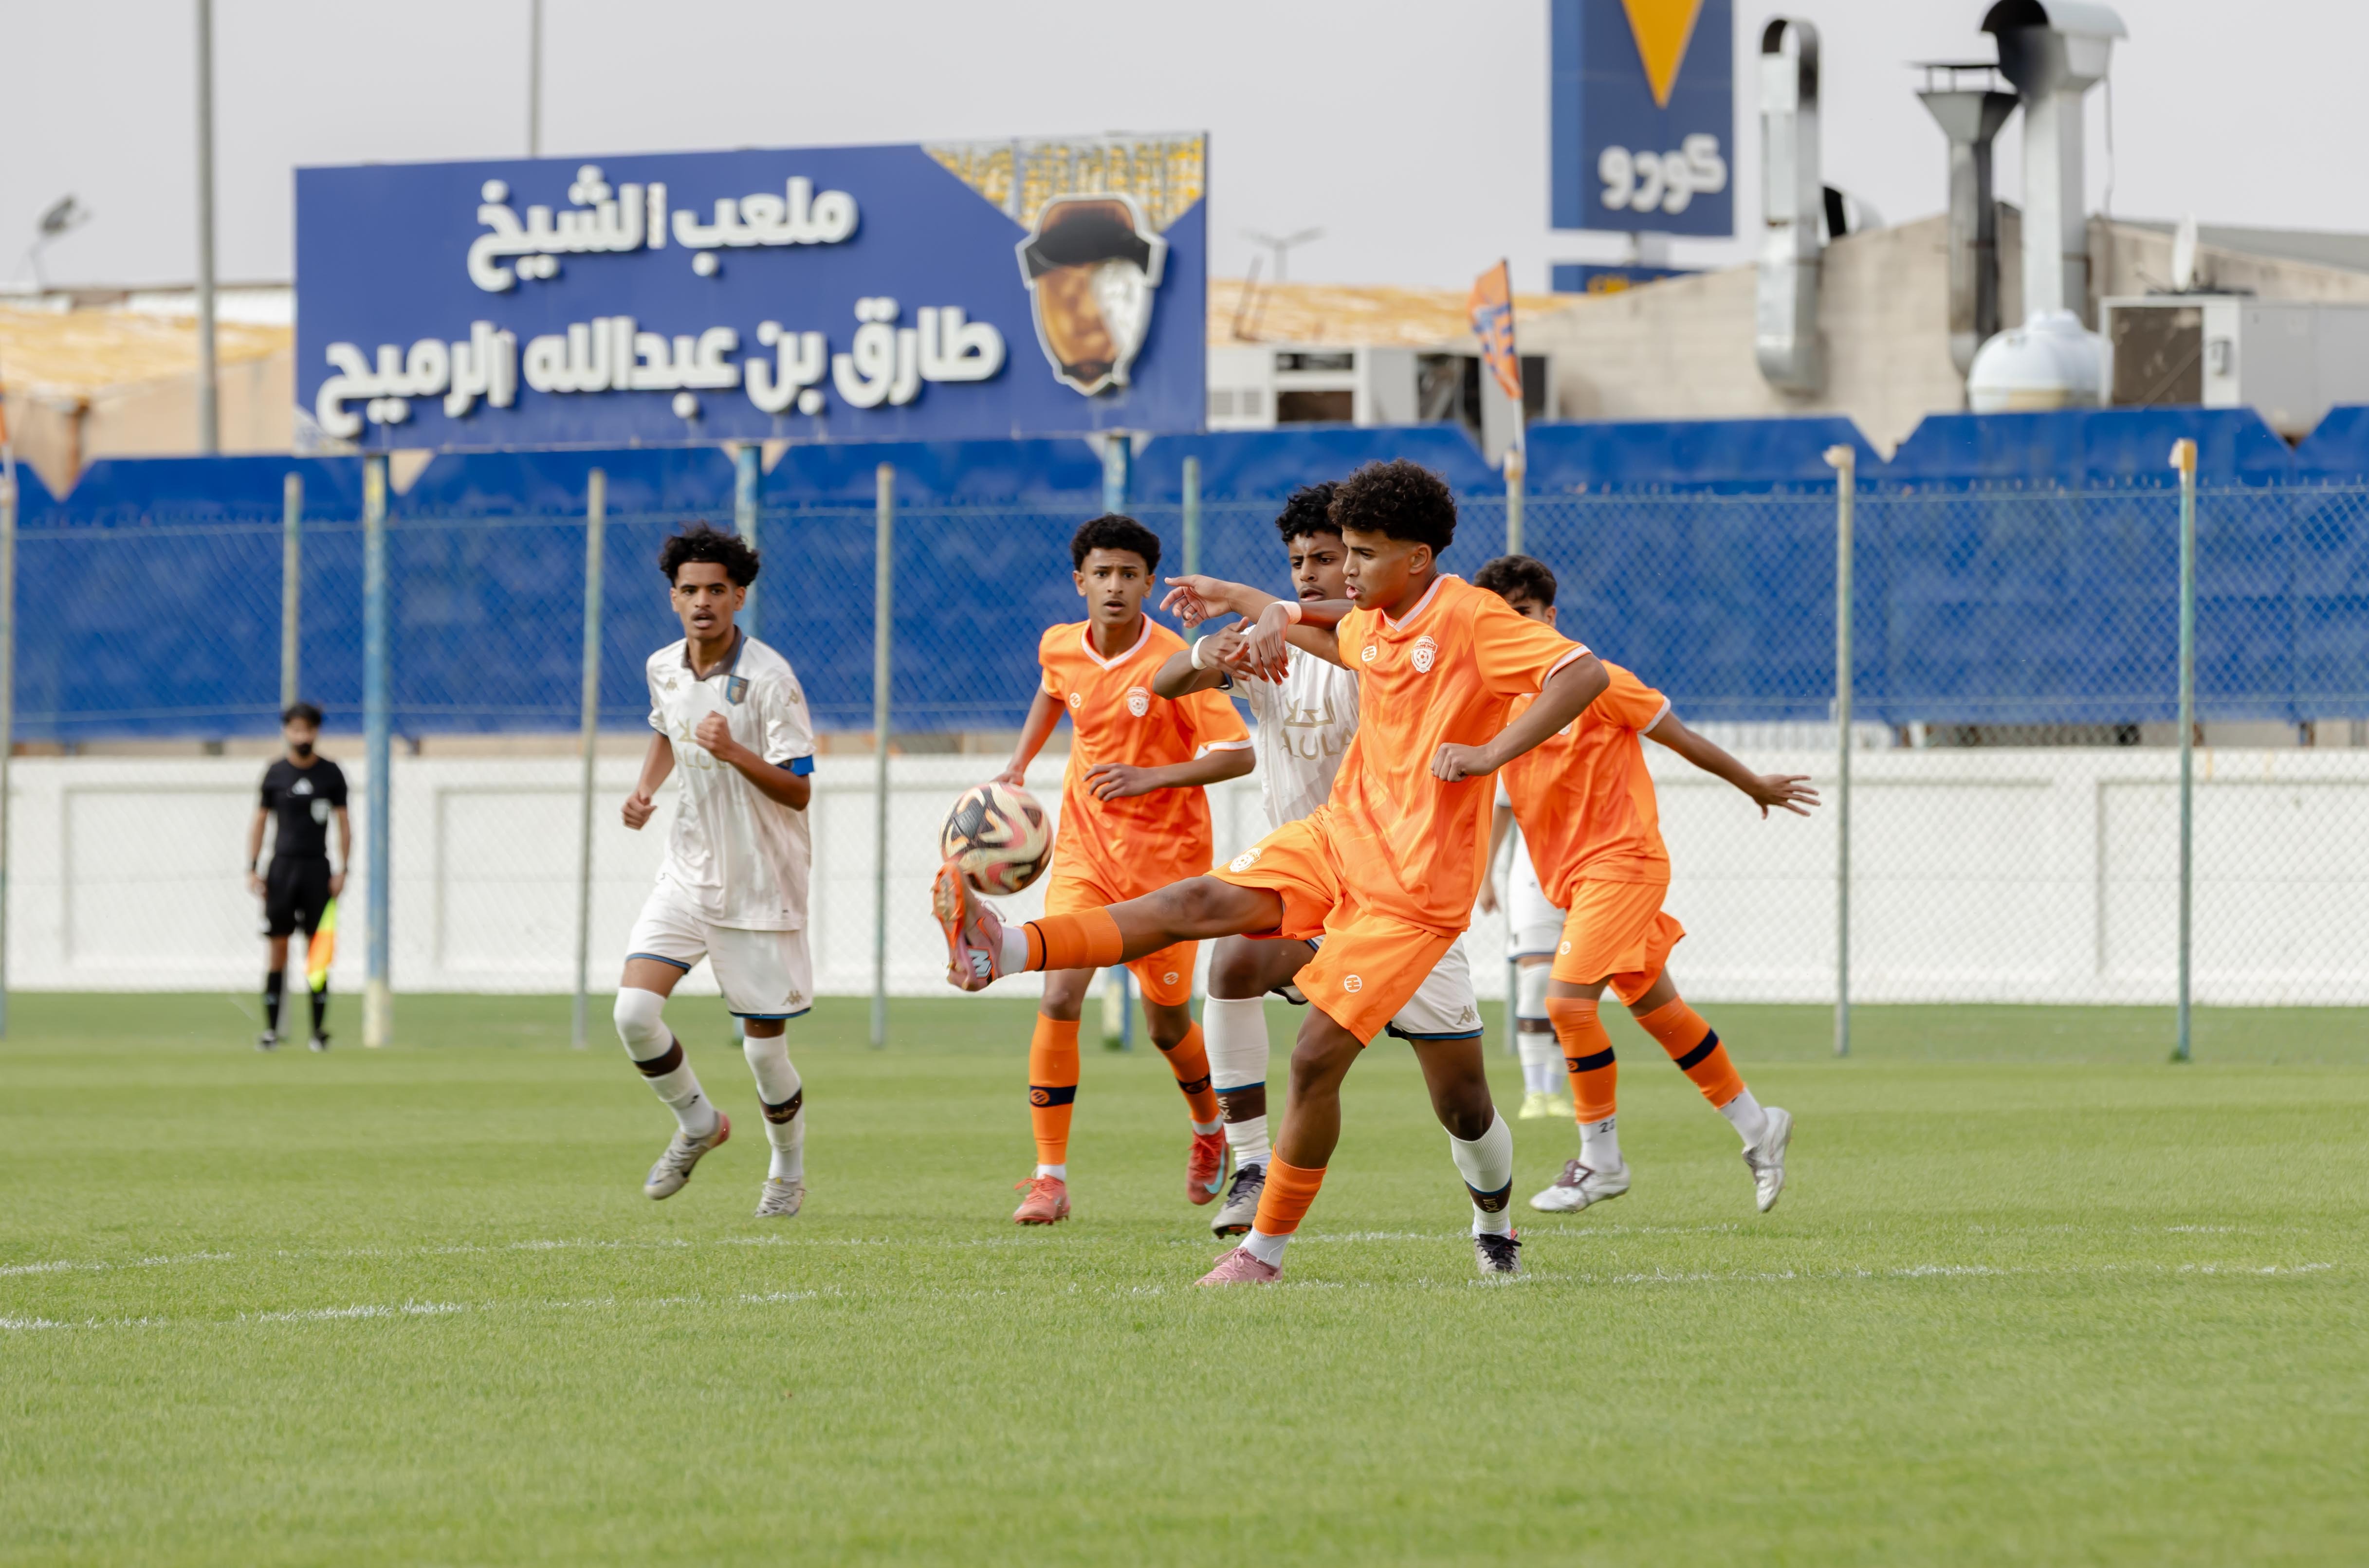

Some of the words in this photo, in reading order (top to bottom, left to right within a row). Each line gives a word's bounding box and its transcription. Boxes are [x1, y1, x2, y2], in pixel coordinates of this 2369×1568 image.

[467, 164, 667, 292] الشيخ
[671, 176, 859, 276] ملعب
[316, 320, 517, 438] الرميح
[524, 316, 740, 419] عبدالله
[745, 320, 826, 415] بن
[832, 296, 1006, 408] طارق
